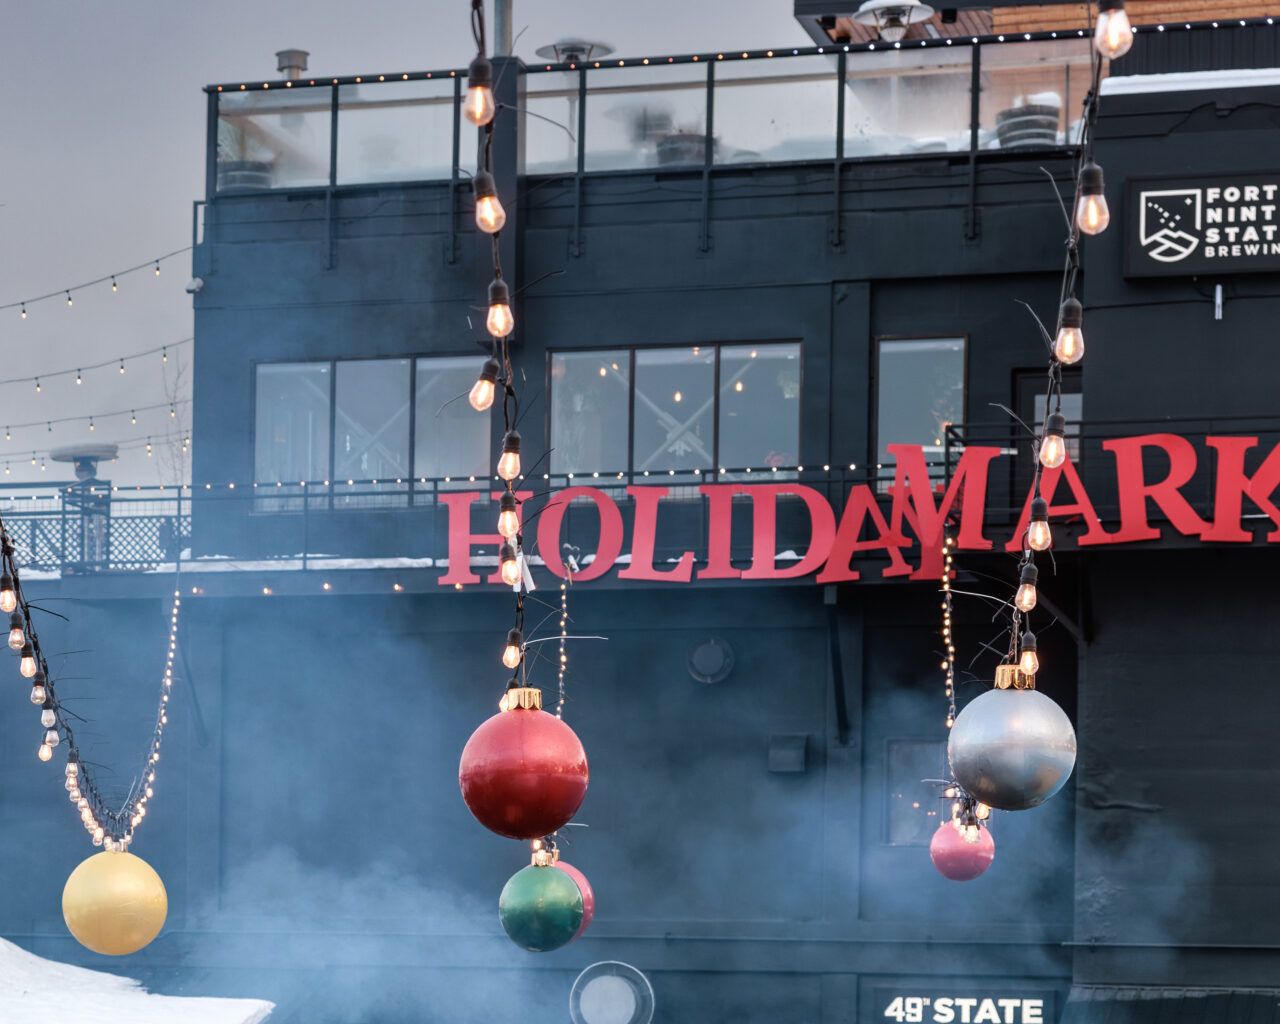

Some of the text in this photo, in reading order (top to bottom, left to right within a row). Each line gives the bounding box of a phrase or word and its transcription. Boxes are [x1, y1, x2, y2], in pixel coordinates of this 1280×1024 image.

[1206, 184, 1278, 203] FORT
[1206, 205, 1276, 224] NINT
[1205, 225, 1278, 244] STAT
[1204, 243, 1280, 258] BREWIN
[887, 432, 1280, 552] MARK
[932, 997, 1044, 1024] STATE
